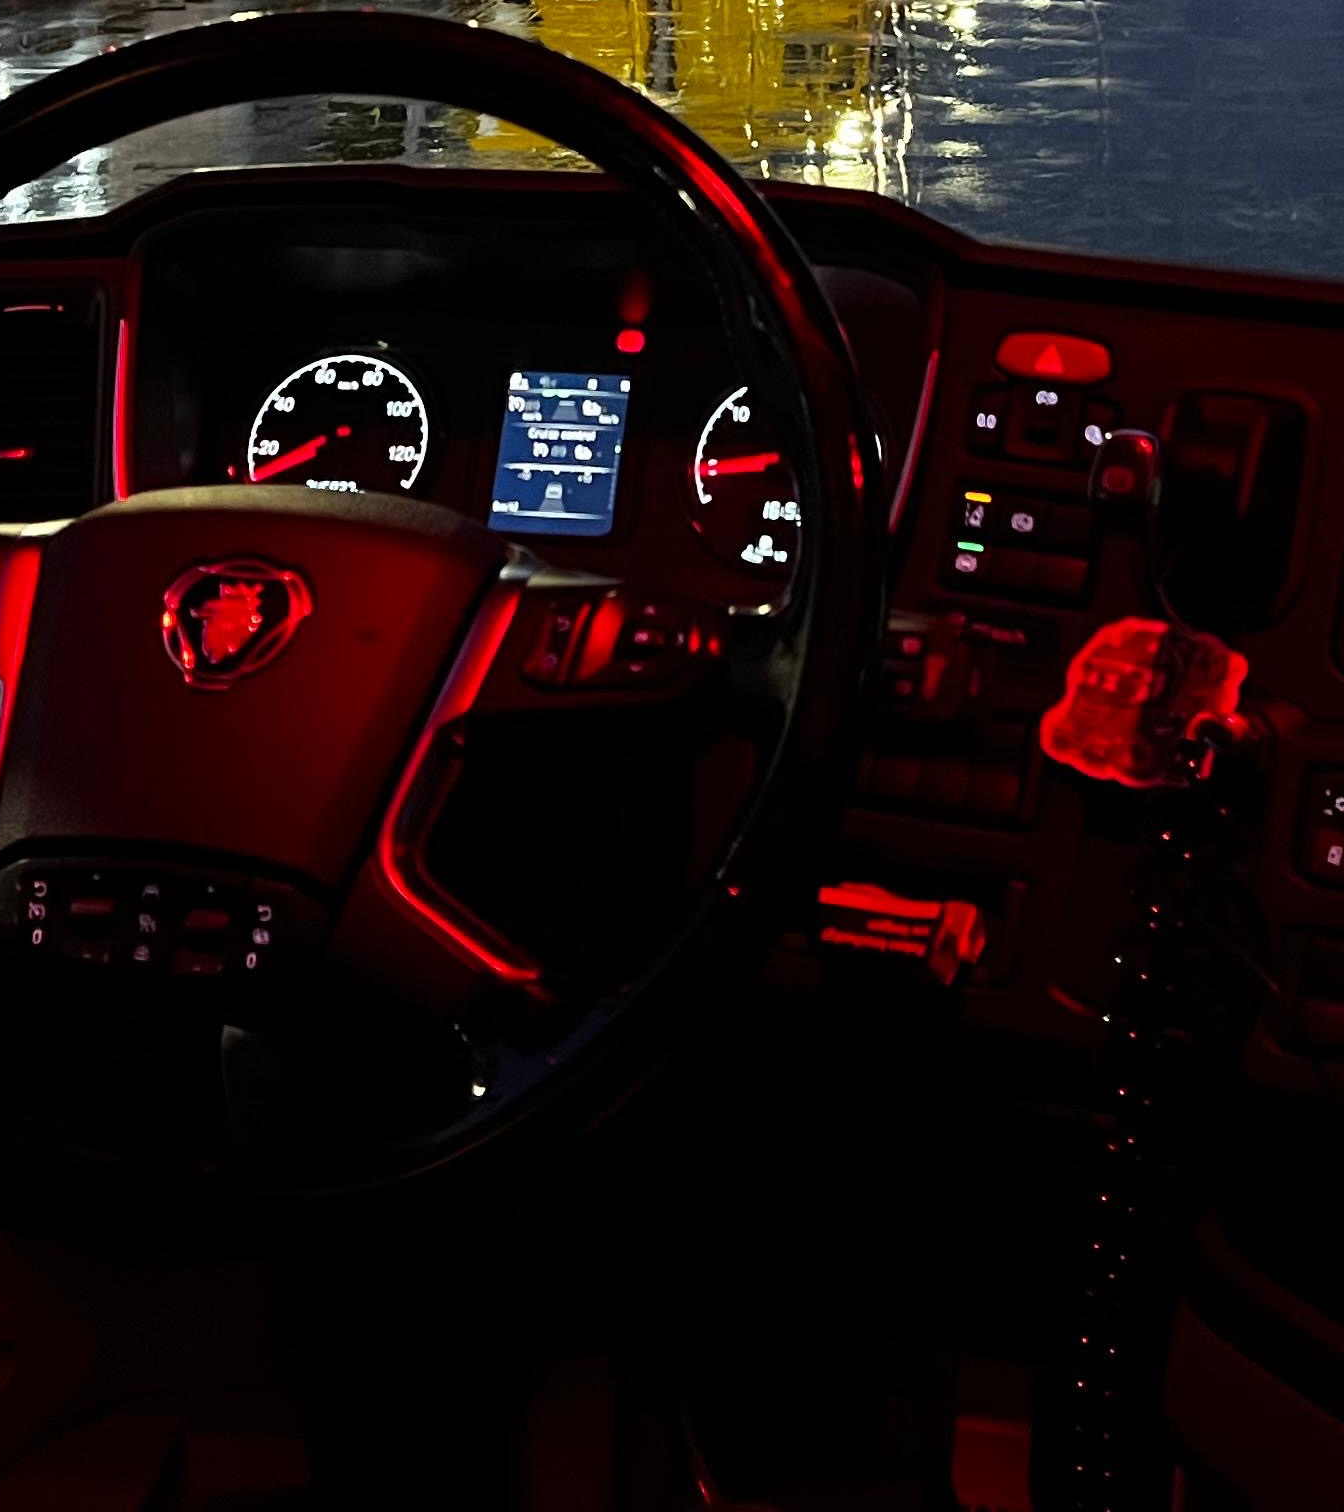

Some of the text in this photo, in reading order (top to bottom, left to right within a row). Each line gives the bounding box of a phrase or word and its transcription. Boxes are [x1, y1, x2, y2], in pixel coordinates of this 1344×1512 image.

[274, 396, 295, 413] 40
[386, 400, 413, 418] 100
[732, 405, 751, 423] 10
[259, 439, 280, 456] 20
[388, 445, 416, 463] 120
